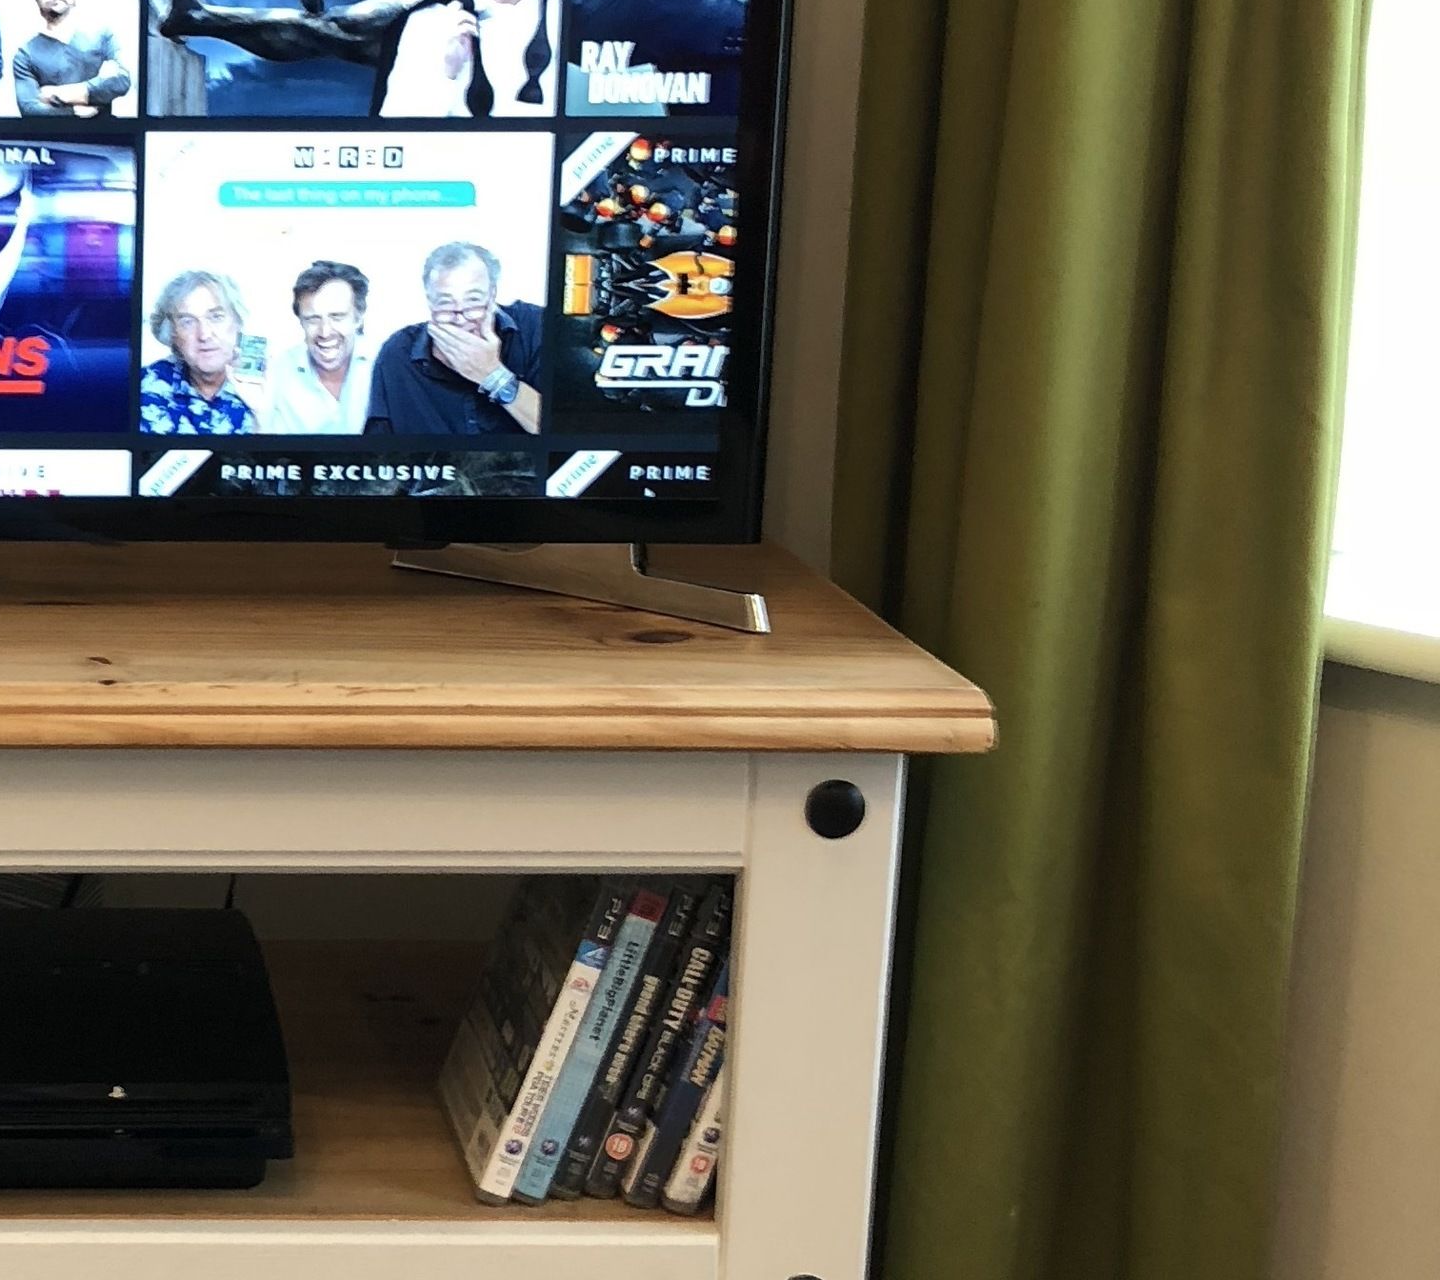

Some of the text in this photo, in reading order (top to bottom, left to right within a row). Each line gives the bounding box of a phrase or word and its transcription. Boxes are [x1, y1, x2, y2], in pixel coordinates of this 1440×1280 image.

[580, 41, 636, 73] RAY
[588, 72, 710, 104] DONOVAN
[654, 147, 738, 164] PRIME
[221, 464, 456, 481] PRIME EXCLUSIVE
[629, 465, 711, 481] PRIME
[596, 897, 623, 940] PS3
[666, 894, 695, 937] PS3
[683, 946, 712, 987] CALL
[588, 940, 641, 1043] LittleBigPlanet
[635, 973, 662, 1016] grand
[663, 988, 694, 1030] DUTY
[689, 1025, 726, 1086] BATMAN
